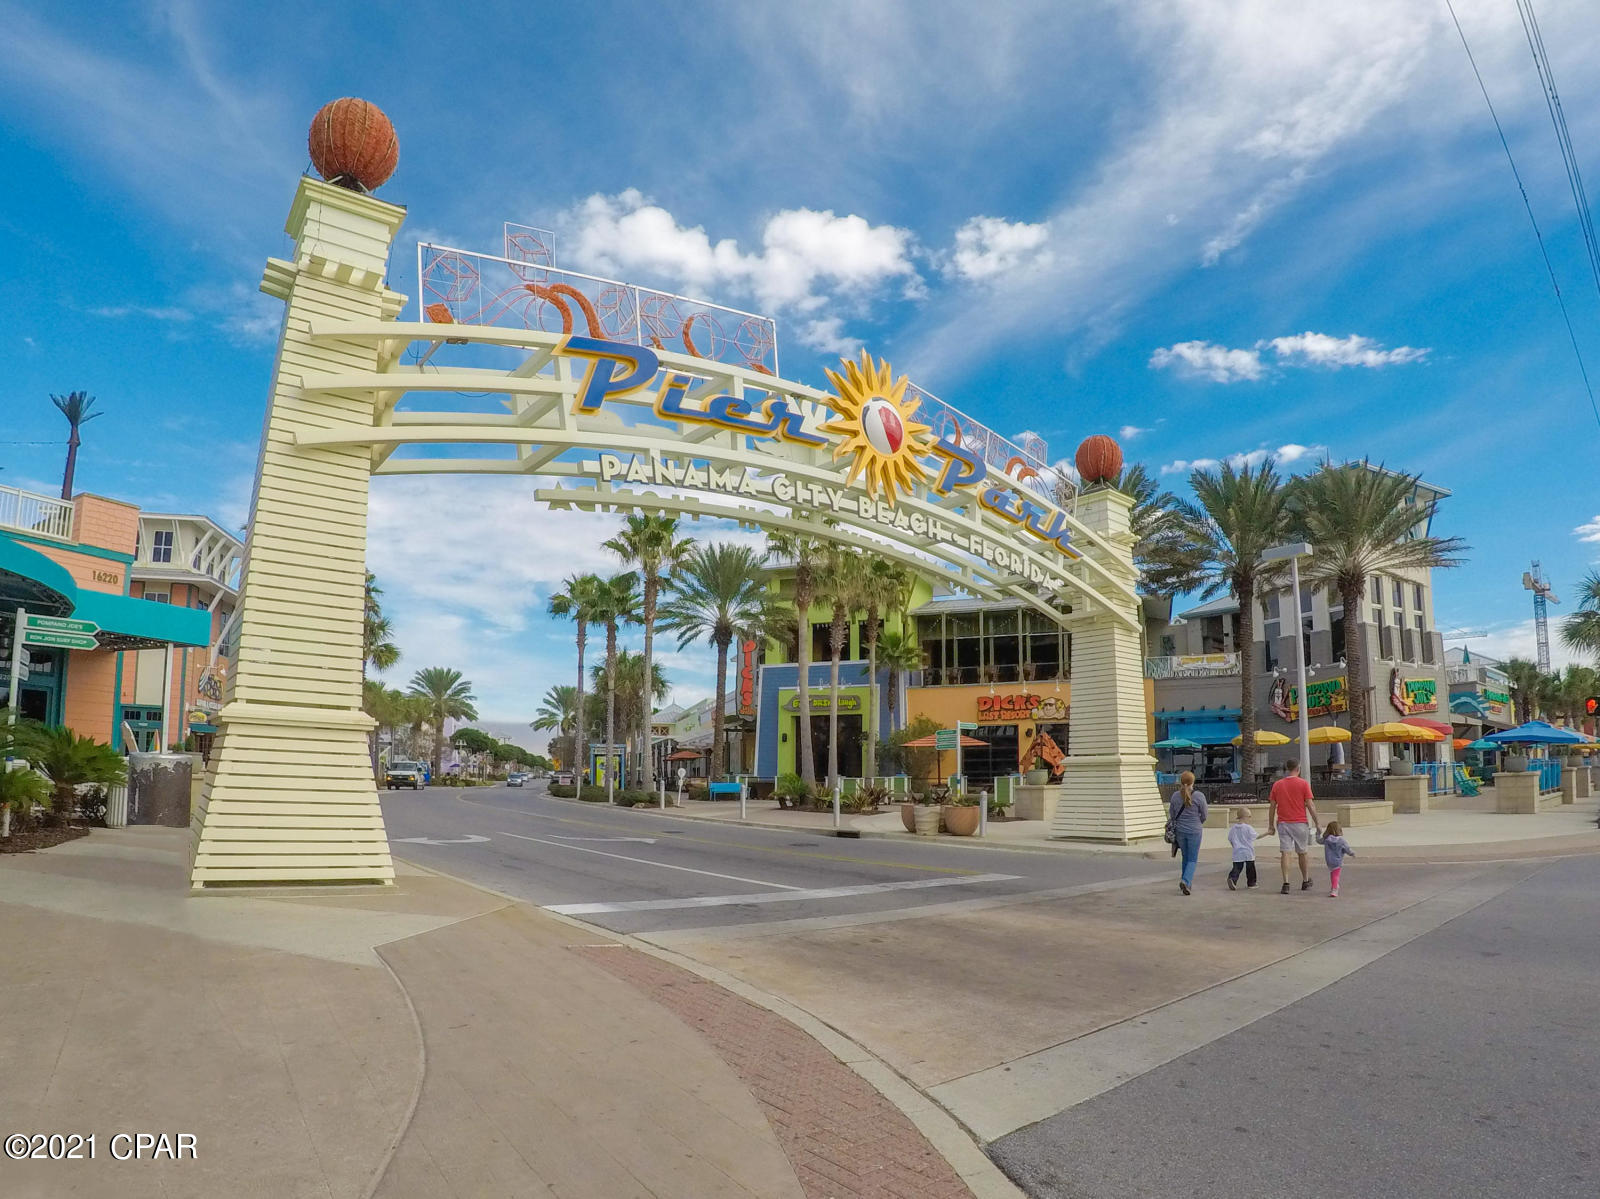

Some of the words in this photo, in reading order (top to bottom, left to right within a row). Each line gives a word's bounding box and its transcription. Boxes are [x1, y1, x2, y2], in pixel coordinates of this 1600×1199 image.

[557, 335, 829, 449] Pier
[930, 435, 1084, 560] Park
[599, 453, 757, 496] PANAMA
[772, 475, 844, 513] CITY
[858, 496, 944, 541] BEACH
[969, 535, 1060, 590] FLORIDA
[92, 570, 119, 584] 16220
[977, 694, 1041, 711] DICK'S
[1290, 679, 1341, 705] PMPANO
